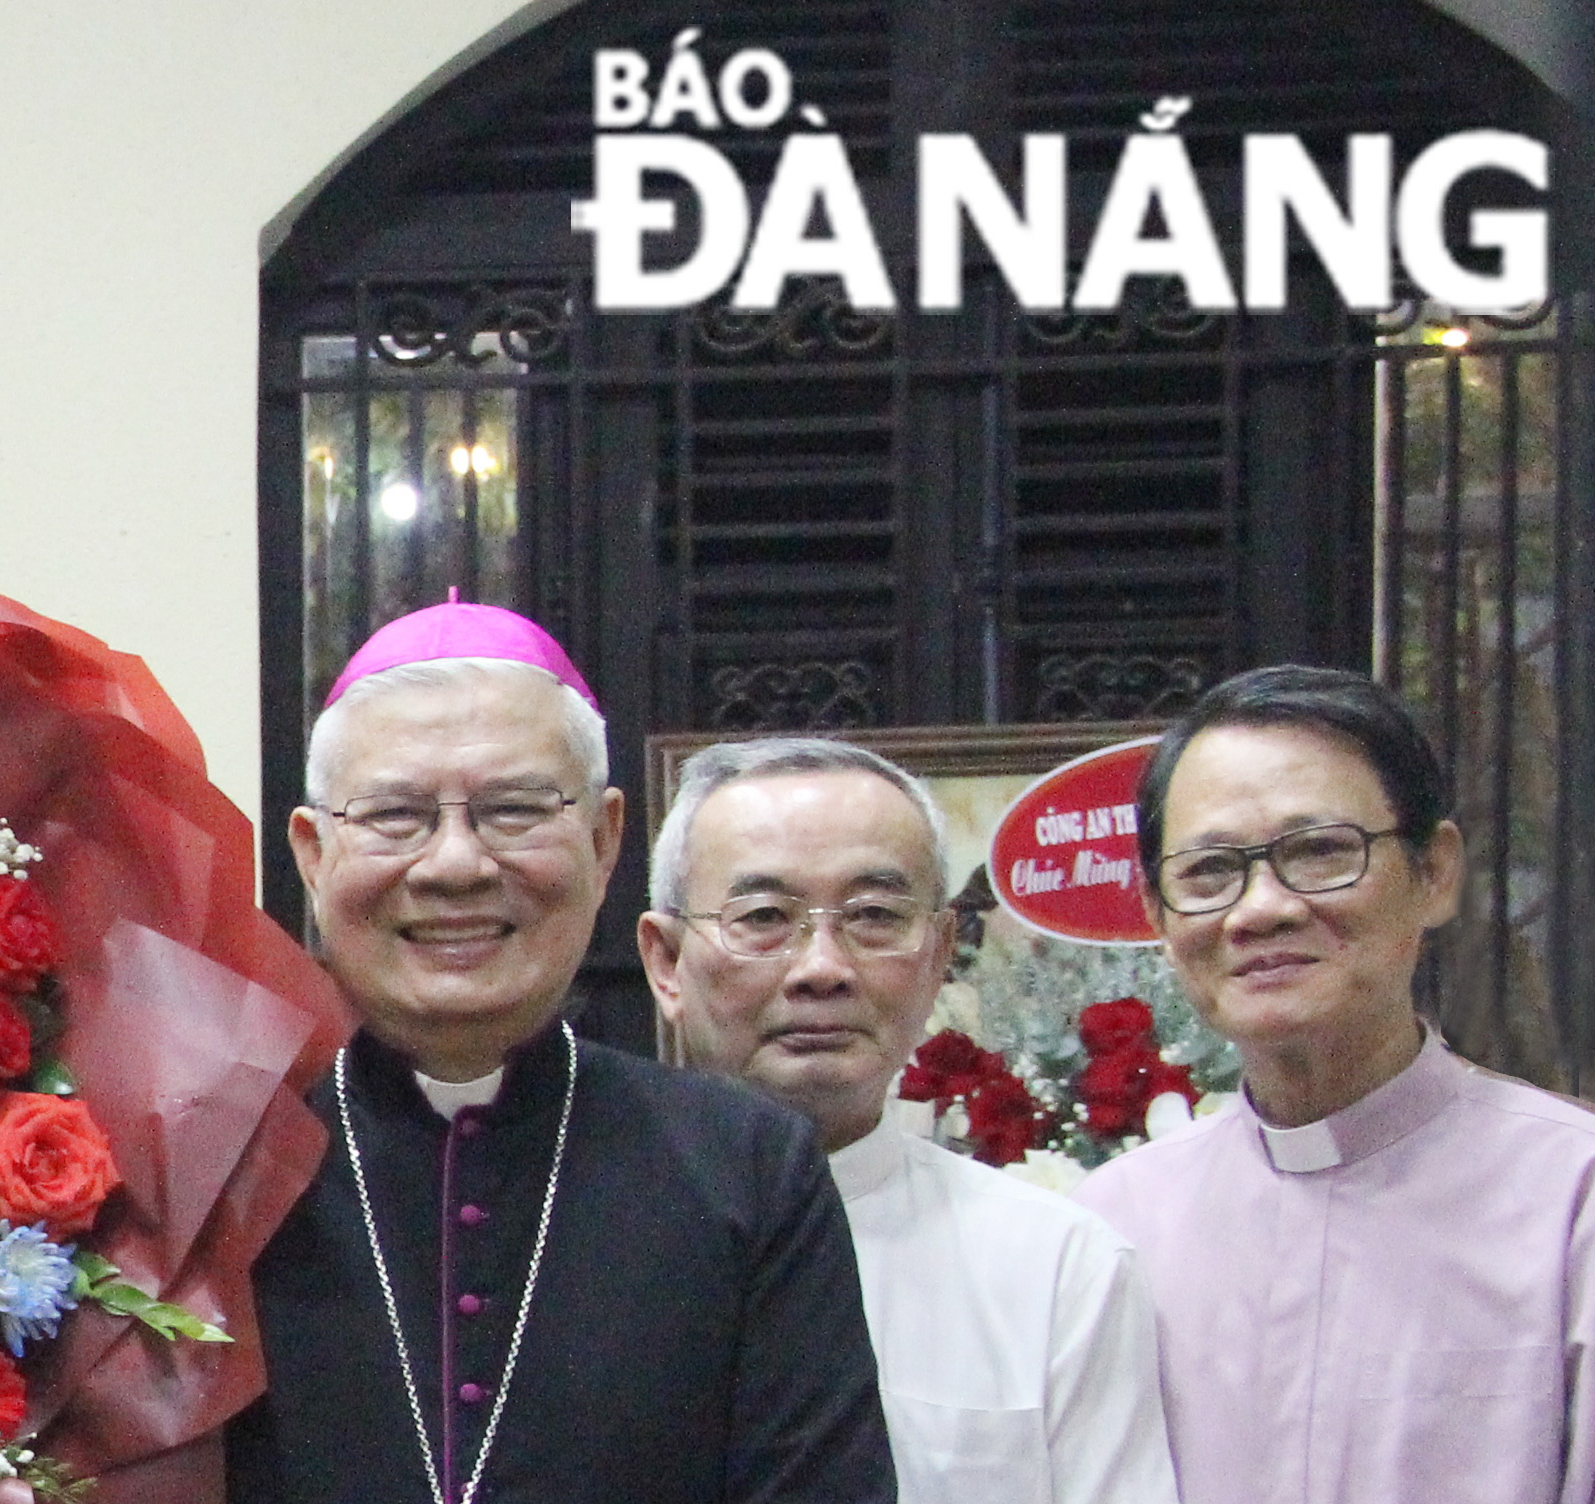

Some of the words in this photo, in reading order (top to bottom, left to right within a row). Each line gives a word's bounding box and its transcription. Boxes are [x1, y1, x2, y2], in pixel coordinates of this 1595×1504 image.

[1035, 806, 1084, 846] CÔNG
[1085, 806, 1112, 840] AN
[1011, 857, 1065, 897] Chúc
[1066, 849, 1132, 890] Mừng
